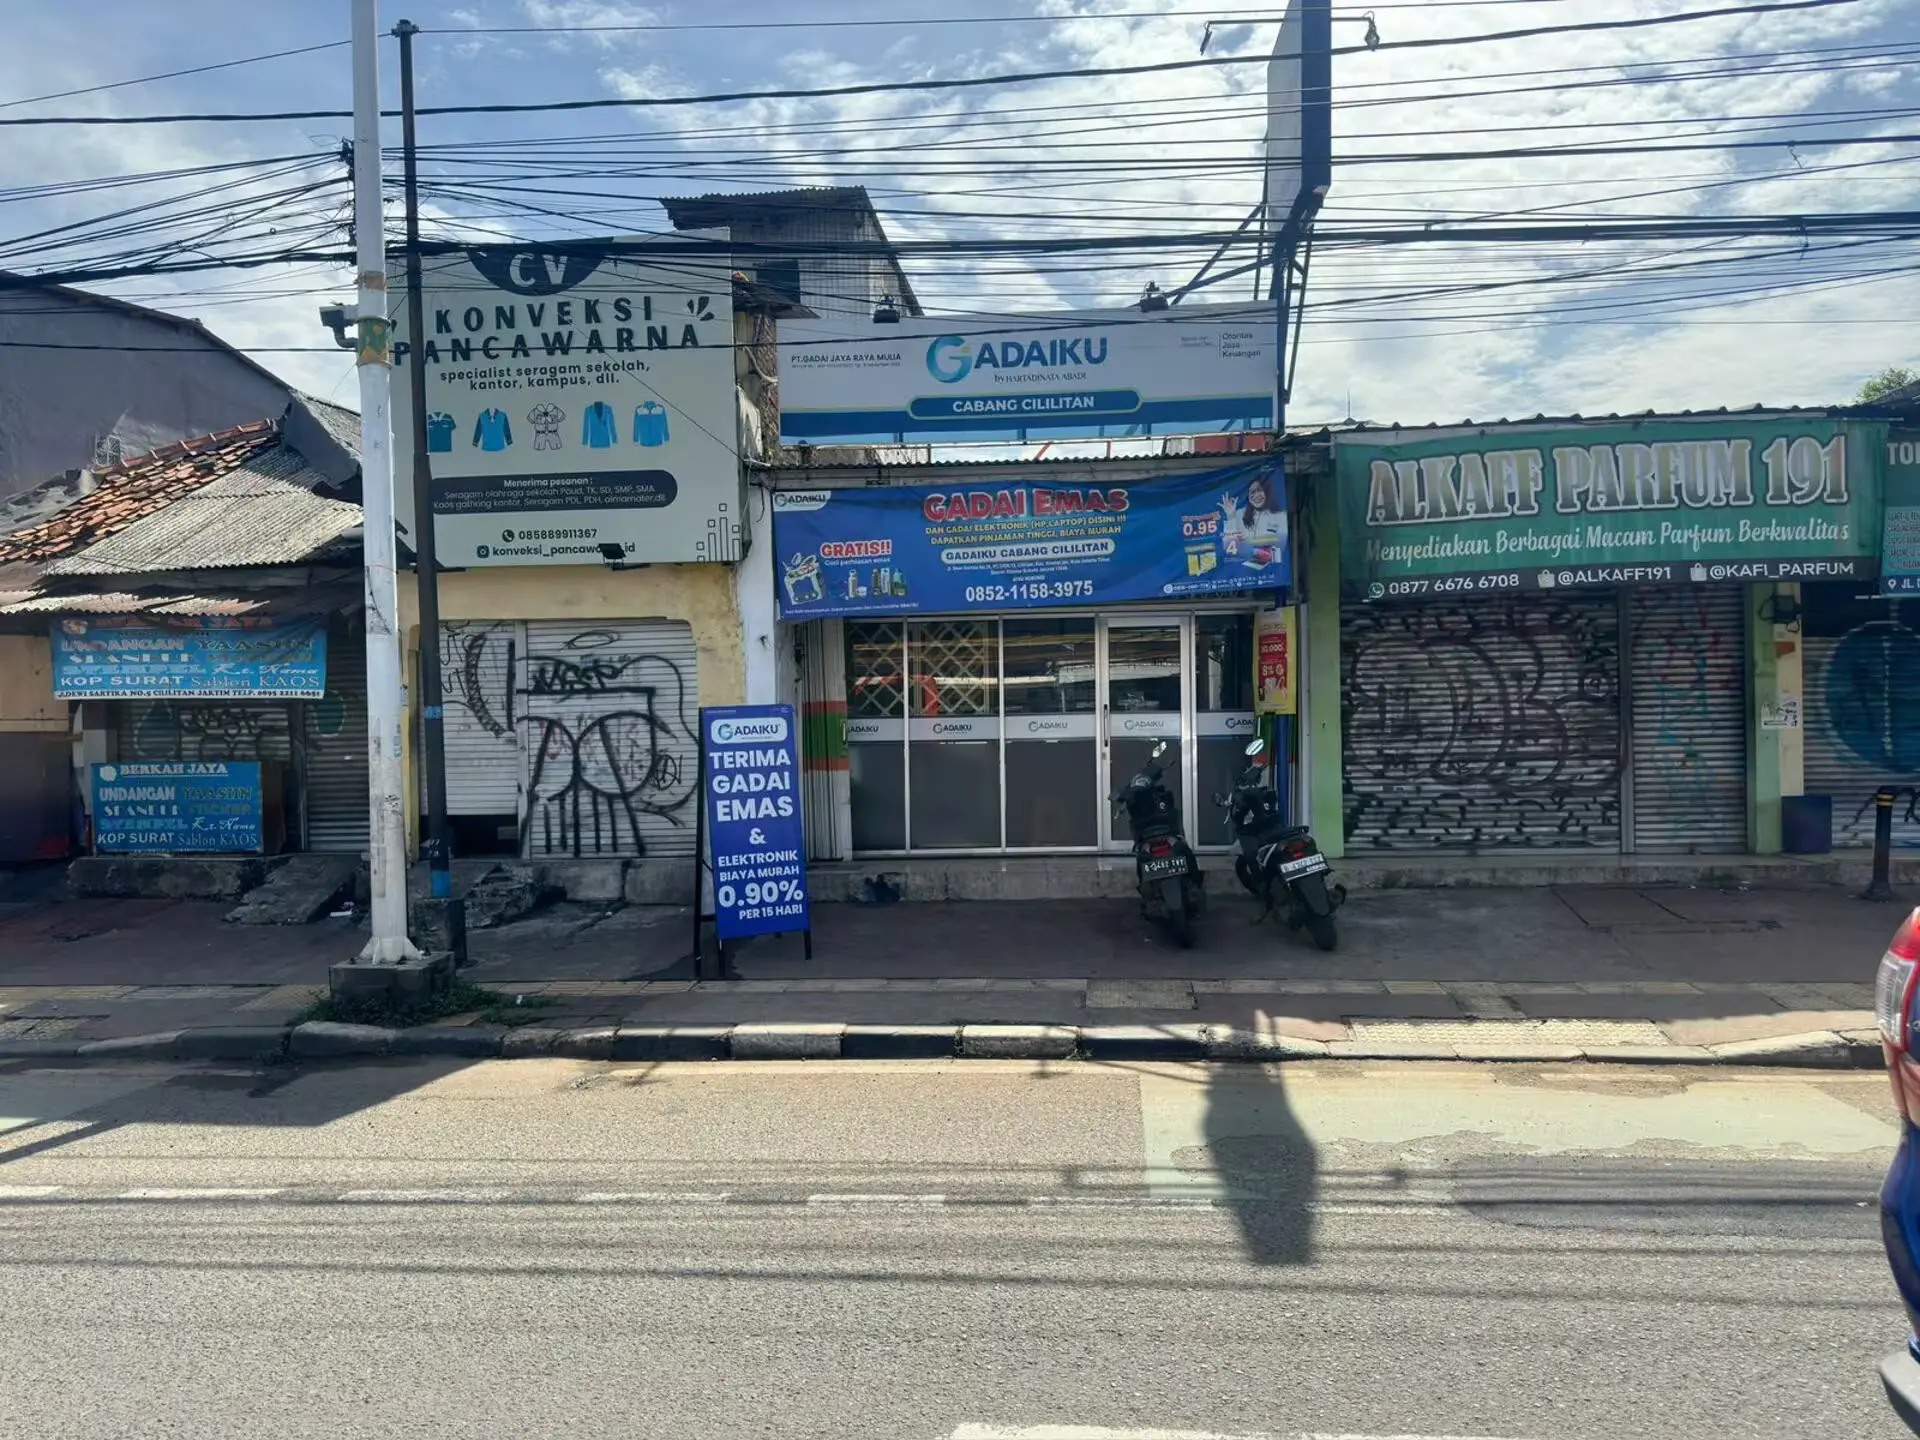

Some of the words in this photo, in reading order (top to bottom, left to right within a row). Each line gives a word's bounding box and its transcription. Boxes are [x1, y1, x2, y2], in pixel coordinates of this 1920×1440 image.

[509, 251, 568, 288] CV
[436, 296, 652, 334] KONVEKSI
[394, 323, 701, 367] PANCAWARNA
[831, 353, 851, 362] JAYA
[853, 353, 875, 362] RAYA
[877, 352, 901, 361] MULIA
[926, 335, 1107, 384] GADAIKU
[440, 367, 512, 384] specialist
[516, 364, 581, 379] seragam
[587, 360, 651, 374] sekolah,
[470, 377, 523, 392] kantor,
[528, 374, 591, 389] kampus,
[596, 372, 620, 385] dll.
[952, 397, 1018, 414] CABANG
[1021, 395, 1095, 411] CILILITAN
[504, 478, 549, 489] Menerima
[1366, 448, 1544, 526] ALKAFF
[1552, 440, 1754, 514] PARFUM
[1762, 435, 1849, 506] 191
[775, 493, 826, 507] GADAIKU
[924, 489, 1027, 523] GADAI
[1033, 488, 1130, 517] EMAS
[518, 528, 598, 542] 085889911367
[931, 536, 977, 545] DAPATKAN
[979, 533, 1025, 542] PINJAMAN
[1060, 528, 1085, 537] BIAYA
[1087, 526, 1121, 535] MURAH
[974, 522, 1028, 532] ELEKTRONIK
[821, 540, 892, 558] GRATIS!!
[1365, 533, 1490, 567] Menyediakan
[1496, 527, 1582, 558] Berbagai
[1586, 525, 1656, 549] Macam
[1660, 521, 1735, 552] Parfum
[1739, 516, 1849, 542] Berkwalitas
[946, 550, 997, 561] GADAIKU
[1000, 546, 1048, 557] CABANG
[1051, 542, 1109, 555] CILILITAN
[1558, 565, 1671, 585] @ALKAFF191
[1710, 561, 1854, 580] @KAFI_PARFUM
[965, 580, 1094, 602] 0852-1158-3975
[1389, 581, 1429, 595] 0877
[1434, 577, 1473, 591] 6676
[1478, 573, 1520, 588] 6708
[61, 676, 102, 687] KOP
[111, 676, 184, 686] SURAT
[259, 676, 320, 688] KAOS
[718, 723, 779, 741] GADAIKU
[932, 723, 973, 736] GADAIKU
[1028, 720, 1068, 732] GADAIKU
[1124, 718, 1164, 731] GADAIKU
[120, 764, 184, 775] BERKAH
[187, 763, 228, 774] JAYA
[709, 749, 791, 770] TERIMA
[712, 771, 790, 794] GADAI
[100, 786, 175, 801] UNDANGAN
[717, 796, 793, 822] EMAS
[97, 832, 125, 845] KOP
[129, 831, 174, 844] SURAT
[177, 832, 216, 847] Sablon
[220, 832, 258, 846] KAOS
[749, 827, 766, 845] &
[718, 850, 798, 867] ELEKTRONIK
[719, 867, 755, 882] BIAYA
[758, 865, 799, 879] MURAH
[718, 879, 804, 908] 0.90%
[739, 907, 760, 920] PER
[761, 906, 774, 918] 15
[775, 904, 803, 916] HARI
